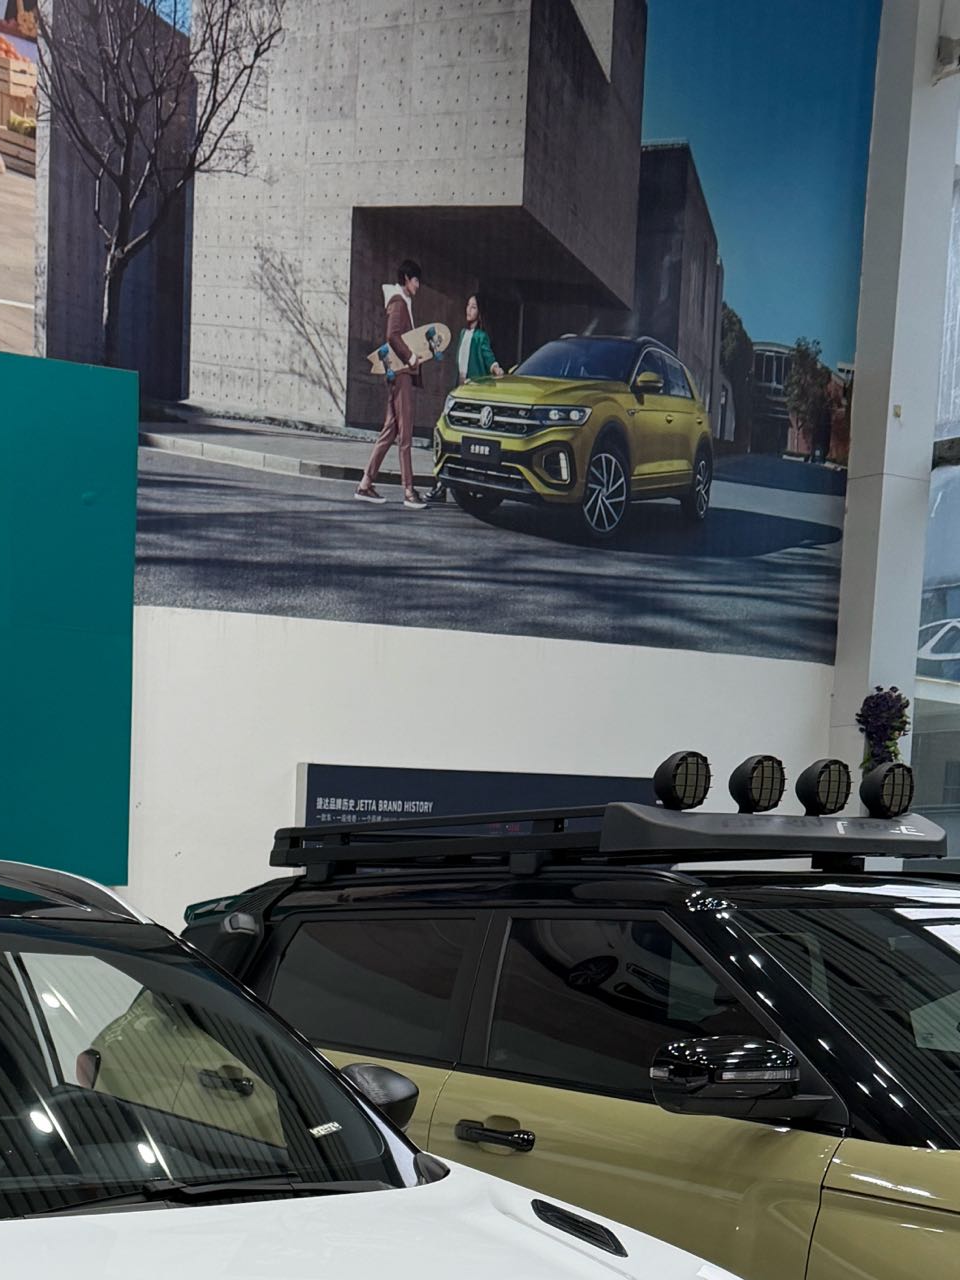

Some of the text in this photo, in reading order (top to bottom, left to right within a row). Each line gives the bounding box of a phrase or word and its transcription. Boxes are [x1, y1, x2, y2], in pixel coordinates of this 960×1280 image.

[356, 800, 377, 812] JETTA
[378, 800, 402, 813] BRAND
[403, 801, 434, 813] HISTORY
